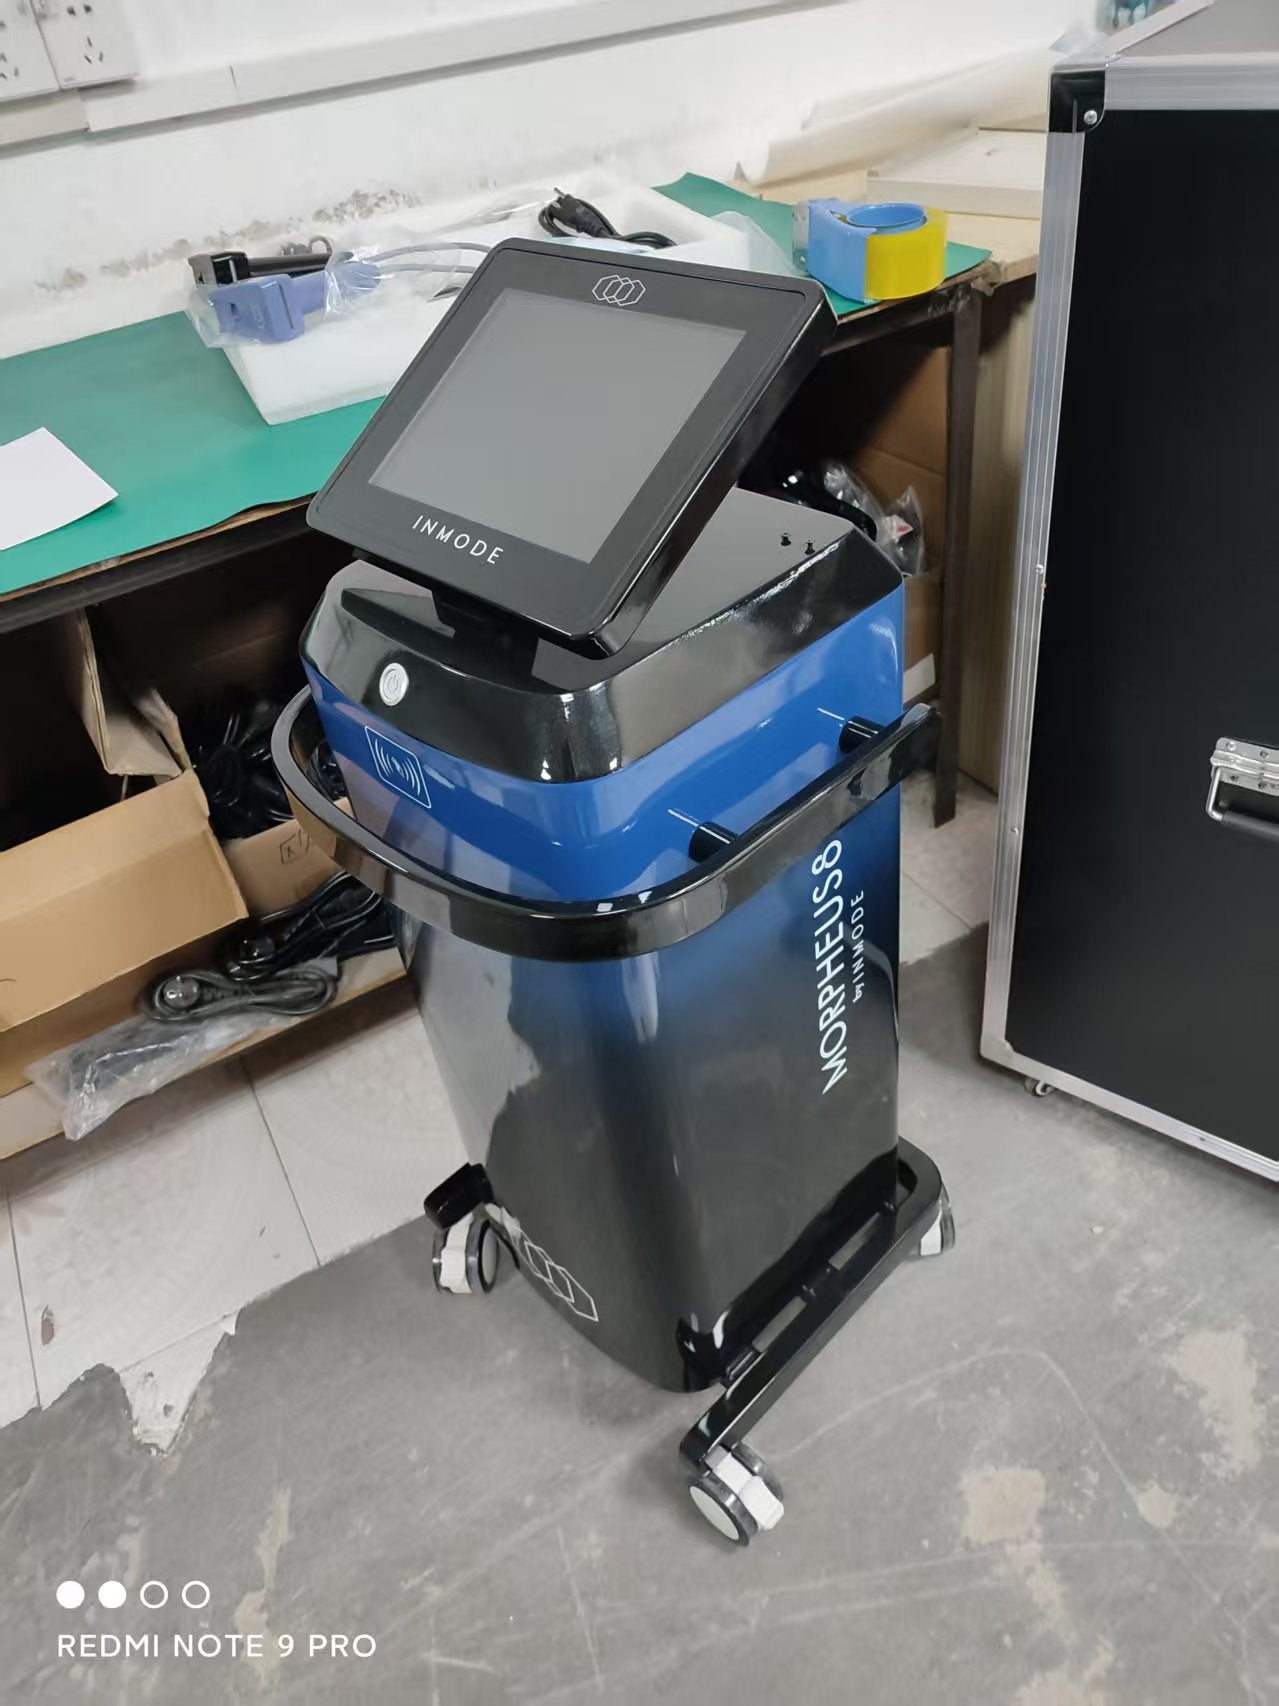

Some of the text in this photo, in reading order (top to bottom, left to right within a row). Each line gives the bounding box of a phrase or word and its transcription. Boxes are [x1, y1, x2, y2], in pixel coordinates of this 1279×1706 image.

[411, 514, 504, 565] INMODE
[811, 839, 848, 1095] MORPHEUS8
[850, 890, 865, 1003] by INMODE
